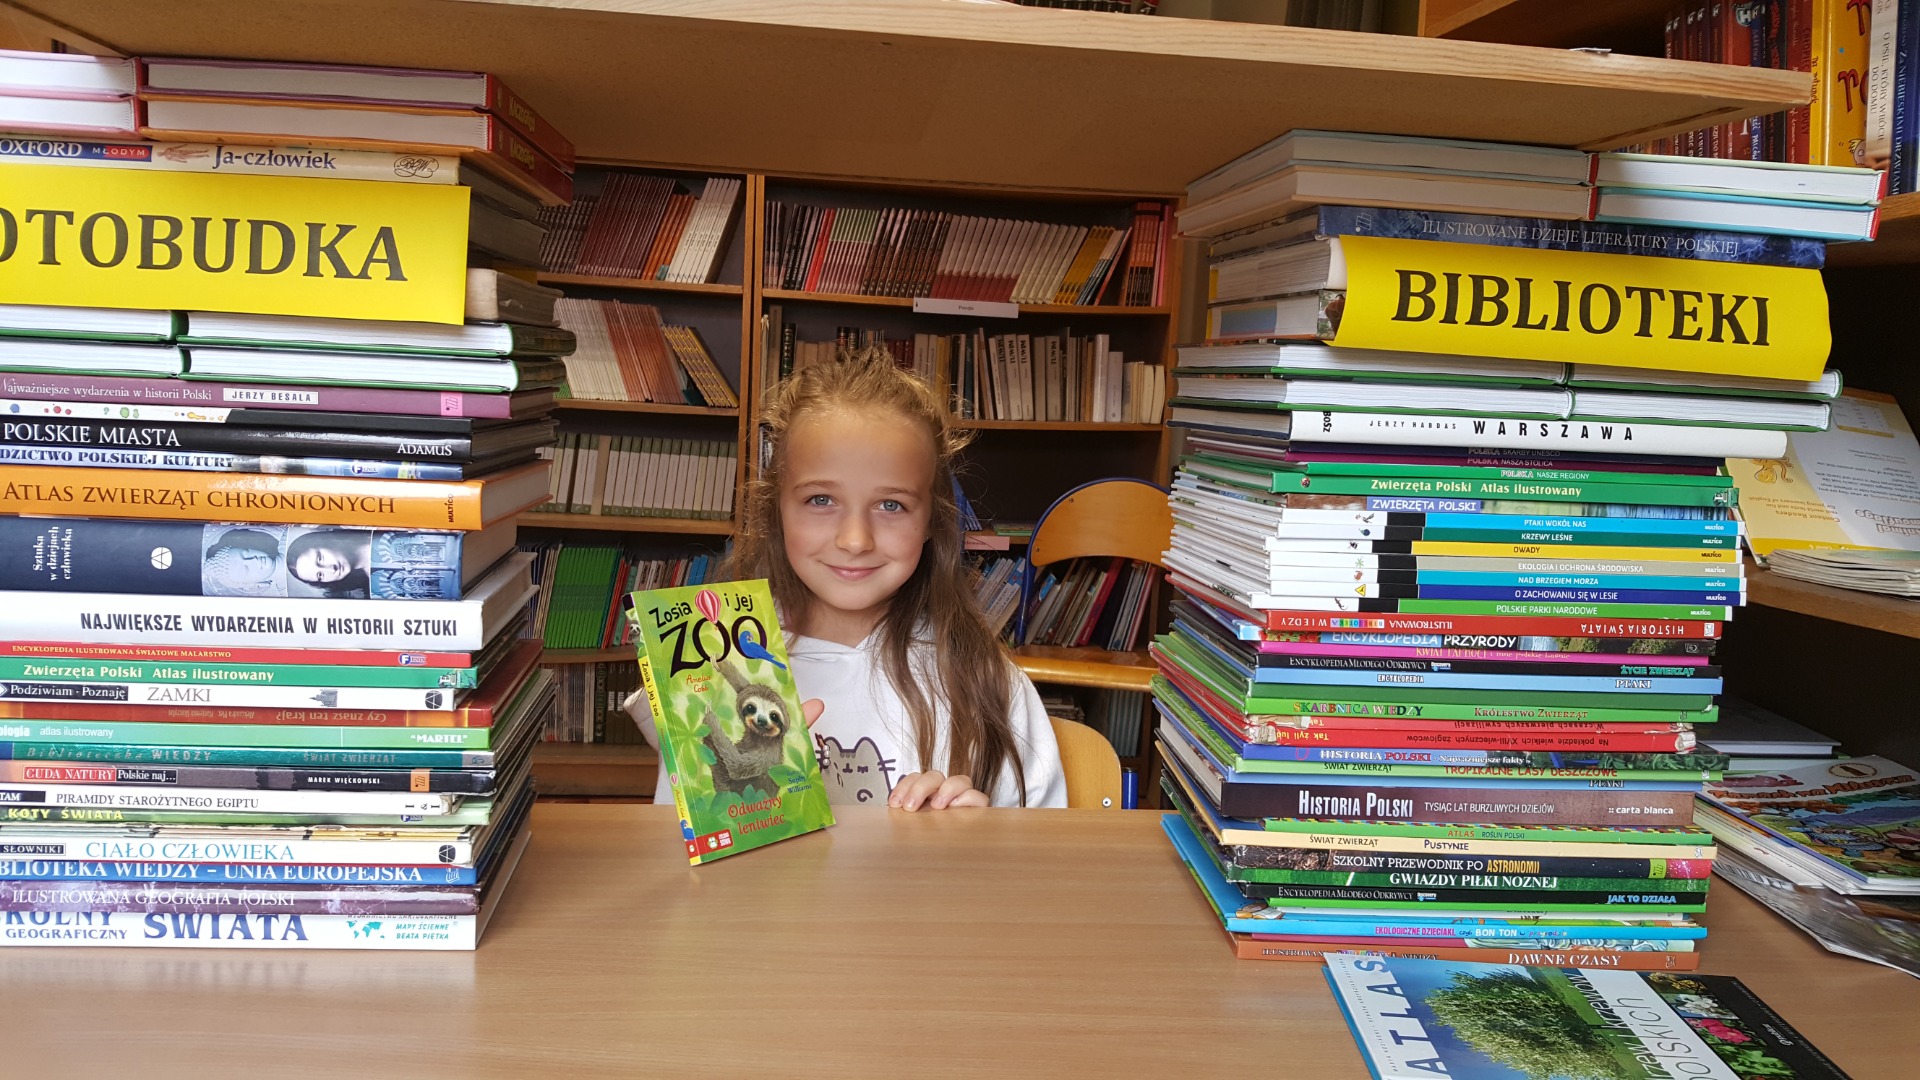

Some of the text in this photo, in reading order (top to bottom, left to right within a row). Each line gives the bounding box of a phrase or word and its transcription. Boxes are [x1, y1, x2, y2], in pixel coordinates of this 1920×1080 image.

[0, 139, 82, 158] OXFORD
[213, 145, 337, 170] Ja-człowiek
[1423, 220, 1739, 257] ILUSTROWANE DZIEJE LITERATURY POLSKIEJ
[1391, 269, 1770, 346] BIBLIOTEKI
[0, 378, 70, 395] Najważniejsze
[73, 386, 129, 398] wydarzenia
[145, 388, 179, 399] historii
[182, 389, 212, 400] Polski
[232, 391, 311, 402] JERZY BESALA
[1370, 420, 1405, 428] JERZY
[1473, 420, 1633, 441] WARSZAWA
[3, 422, 181, 447] POLSKIE MIASTA
[397, 442, 452, 456] ADAMUS
[78, 452, 157, 465] POLSKIEJ
[162, 454, 235, 468] KULTURY
[1371, 479, 1582, 497] Zwierzęta Polski Atlas ilustrowany
[4, 481, 396, 514] ATLAS ZWIERZĄT CHRONIONYCH
[1372, 499, 1476, 512] ZWIERZĘTA POLSKI
[32, 535, 44, 571] Sztuka
[47, 526, 59, 570] dziejach
[63, 528, 73, 580] człowieka
[1513, 546, 1540, 554] OWADY
[1518, 563, 1644, 572] EKOLOGIA OCHRONA ŚRODOWISKA
[1536, 577, 1572, 585] BRZEGIEM
[1522, 590, 1618, 600] ZACHOWANIU LESIE
[649, 594, 753, 628] Zosia i jej
[1496, 605, 1598, 615] POLSKIE PARKI NARODOWE
[80, 613, 457, 636] NAJWIĘKSZE WYDARZENIA W HISTORII SZTUKI
[1281, 617, 1453, 630] ILUSTROWANA WIEDZY
[1581, 623, 1684, 635] HISTORIA ŚWIATA
[659, 616, 768, 678] ZOO
[1444, 634, 1517, 649] PRZYRODY
[12, 645, 231, 658] ENCYKLOPEDIA ILUSTROWANA ŚWIATOWE MALARSTWO
[23, 665, 274, 682] Zwierzęta Polski Atlas ilustrowany
[1621, 665, 1695, 677] ŻYCIE ZWIERZĄT
[1377, 674, 1424, 683] ENCYKLOPEDIA
[1615, 679, 1652, 689] PTAKI
[10, 685, 126, 699] Podziwiam Poznaję
[147, 687, 211, 702] ZAMKI
[1294, 702, 1423, 716] SKARBNICA WIEDZY
[276, 710, 387, 723] Czy znasz ten kraj?
[40, 726, 114, 739] atlas ilustrowany
[152, 751, 212, 761] WIEDZY
[1320, 750, 1431, 761] HISTORIA POLSKI
[26, 767, 115, 780] CUDA NATURY
[117, 770, 176, 783] Polskie naj...
[1445, 766, 1617, 777] TROPIKALNE LASY DESZCZOWE
[308, 776, 380, 785] MAREK WIĘCKOWSKI
[56, 794, 259, 808] PIRAMIDY STAROŻYTNEGO EGIPTU
[728, 795, 783, 819] Odważny
[1299, 790, 1413, 818] HISTORIA POLSKI
[1424, 802, 1554, 813] TYSIĄC LAT BURZLIWYCH DZIEJÓW
[8, 808, 123, 820] KOTY ŚWIATA
[1616, 806, 1673, 814] carta blanca
[737, 813, 785, 835] leniwiec
[1310, 836, 1378, 847] ŚWIAT ZWIERZĄT
[1424, 840, 1469, 850] PUSTYNIE
[4, 845, 62, 853] SŁOWNIKI
[86, 843, 294, 860] CIAŁO CZŁOWIEKA
[1333, 855, 1540, 873] SZKOLNY PRZEWODNIK PO ASTRONOMII
[115, 863, 199, 878] WIEDZY
[224, 866, 278, 880] UNIA
[283, 866, 423, 881] EUROPEJSKA
[1390, 872, 1498, 887] GWIAZDY PIŁKI
[13, 890, 295, 906] ILUSTROWANA GEOGRAFIA POLSKI
[1608, 895, 1676, 903] JAK TO DZIAŁA
[6, 928, 128, 940] GEOGRAFICZNY
[1475, 929, 1496, 937] BON
[1508, 953, 1621, 966] DAWNE CZASY
[1353, 959, 1451, 1075] ATLAS
